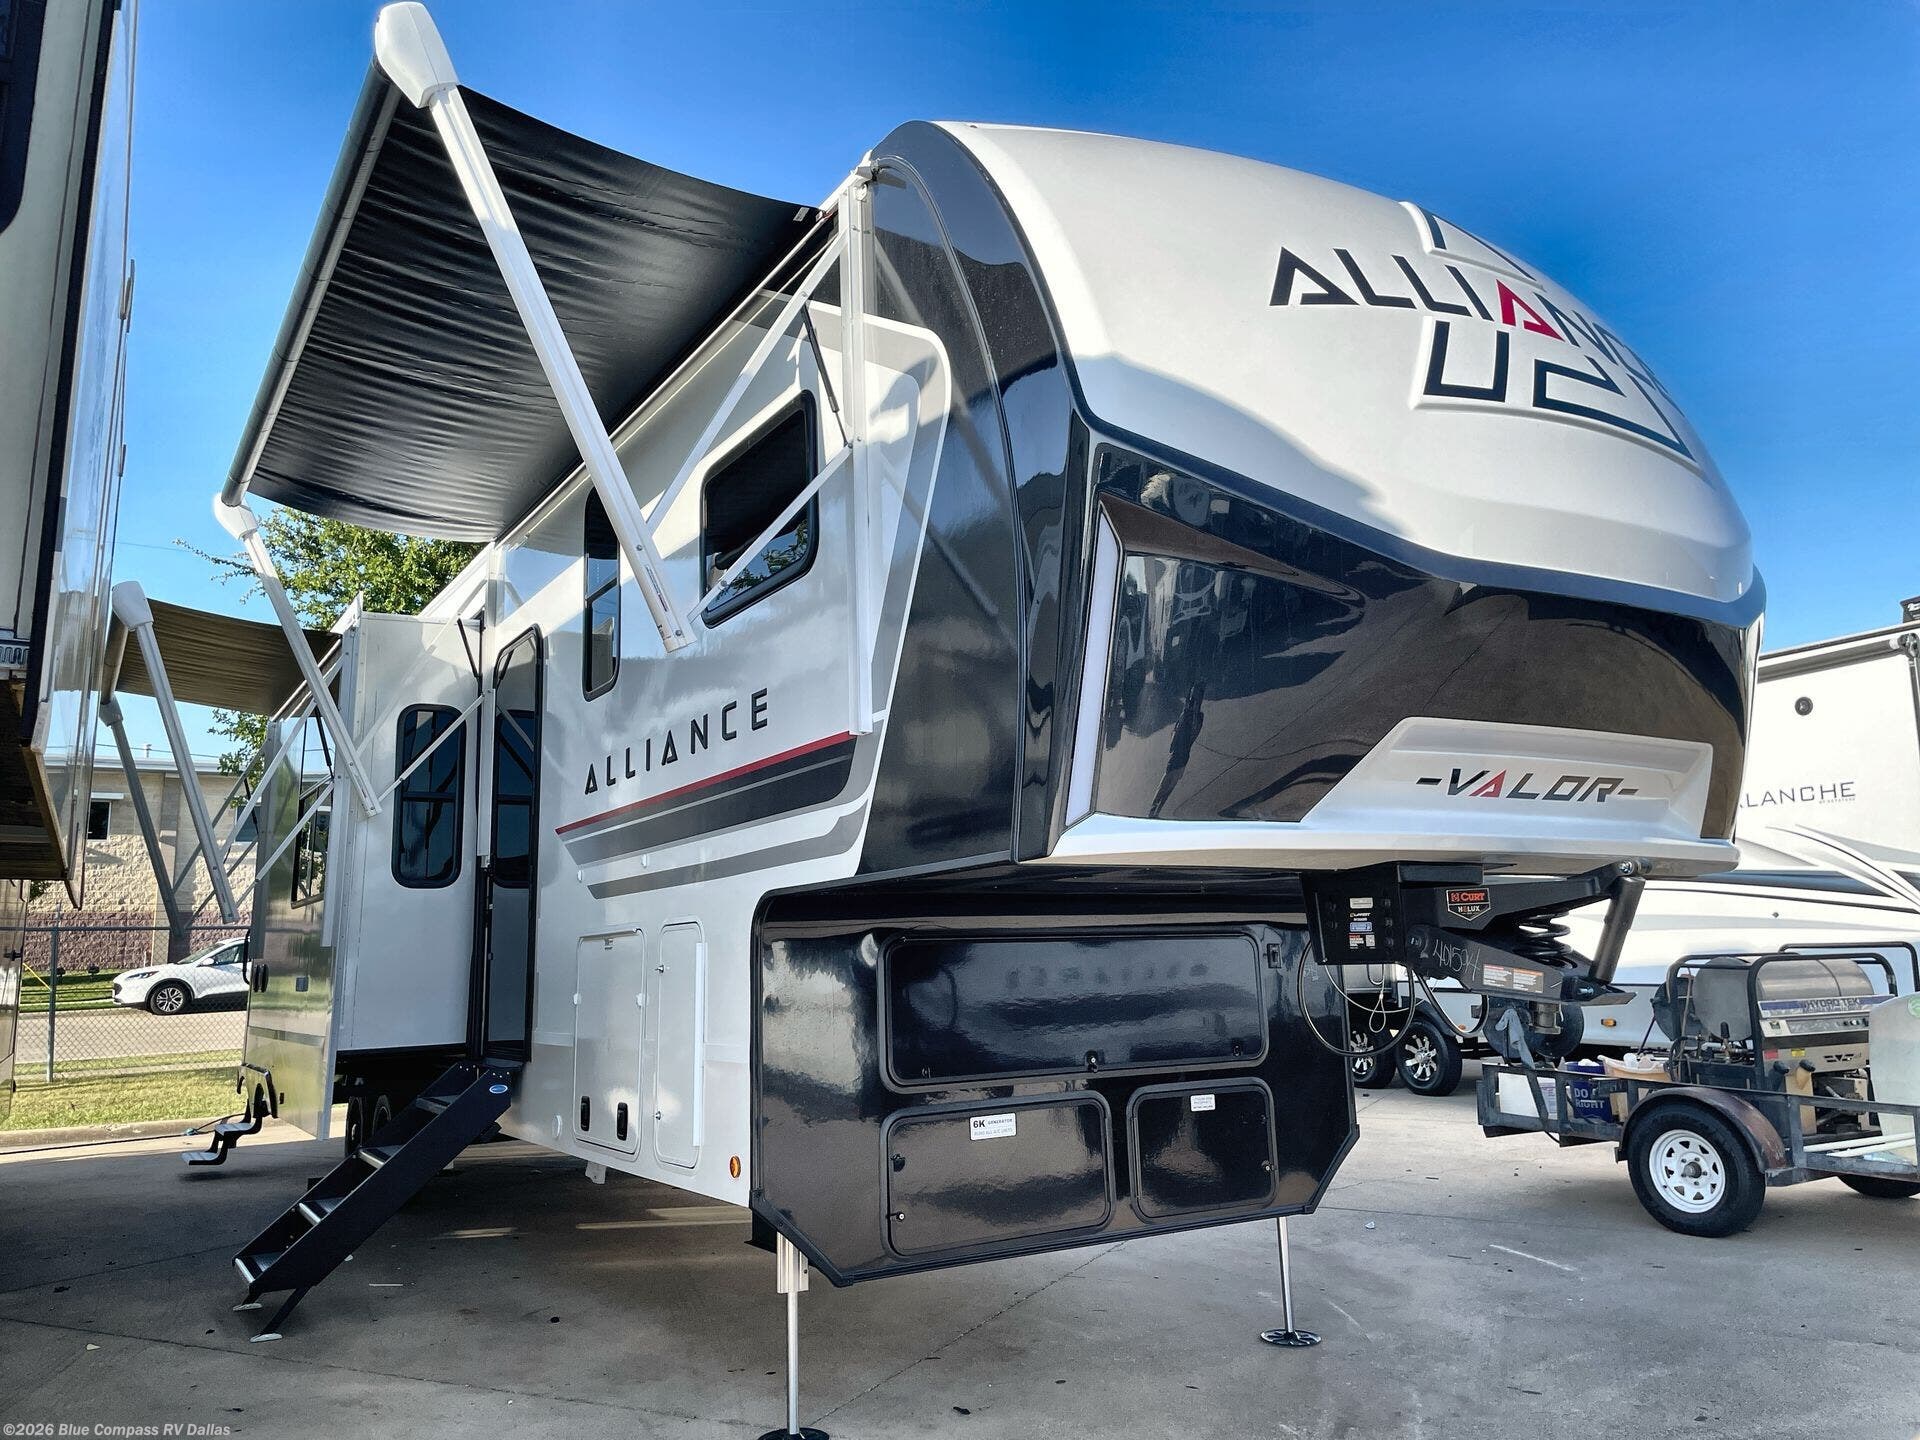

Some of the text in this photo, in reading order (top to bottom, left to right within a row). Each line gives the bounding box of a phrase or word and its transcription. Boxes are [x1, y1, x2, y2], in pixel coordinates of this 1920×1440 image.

[584, 687, 769, 796] ALLIANCE
[1740, 781, 1856, 808] LANCHE
[1573, 1087, 1589, 1099] DO
[973, 1120, 985, 1128] 6K
